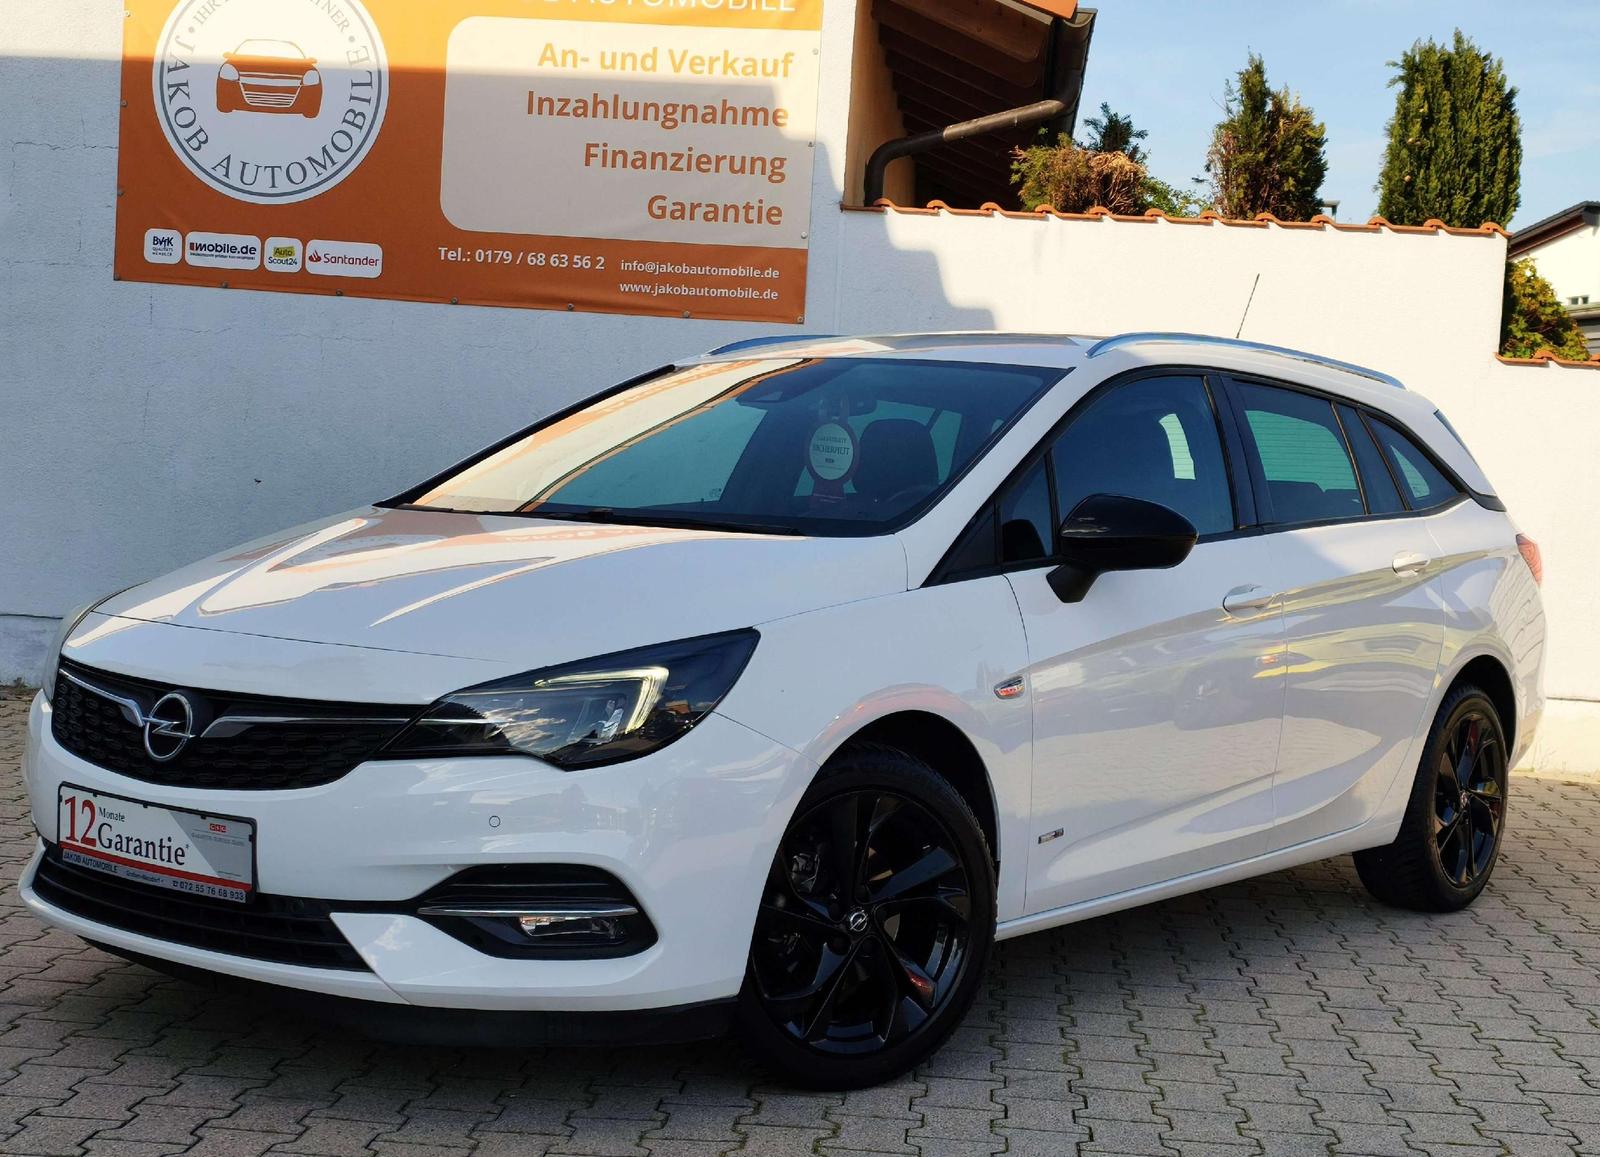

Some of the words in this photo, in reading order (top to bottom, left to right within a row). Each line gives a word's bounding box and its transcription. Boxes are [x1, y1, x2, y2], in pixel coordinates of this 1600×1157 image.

[537, 42, 590, 69] An-
[599, 46, 658, 73] und
[668, 48, 795, 79] Verkauf
[167, 35, 211, 153] JAKOB
[211, 45, 374, 189] AUTOMOBILE
[527, 90, 790, 131] Inzahlungnahme
[584, 142, 788, 184] Finanzierung
[647, 194, 784, 226] Garantie
[195, 242, 257, 256] mobile.de
[274, 246, 294, 256] Auto
[323, 253, 380, 267] Santander
[438, 247, 472, 263] Tel.:
[475, 249, 513, 265] 0179
[527, 252, 547, 267] 68
[550, 253, 569, 268] 63
[573, 254, 592, 270] 56
[595, 255, 606, 270] 2
[268, 256, 298, 266] Scout24
[620, 259, 781, 280] info@jakobautomobile.de
[619, 282, 779, 301] www.jakobautomobile.de
[64, 795, 98, 848] 12
[98, 806, 126, 823] Monate
